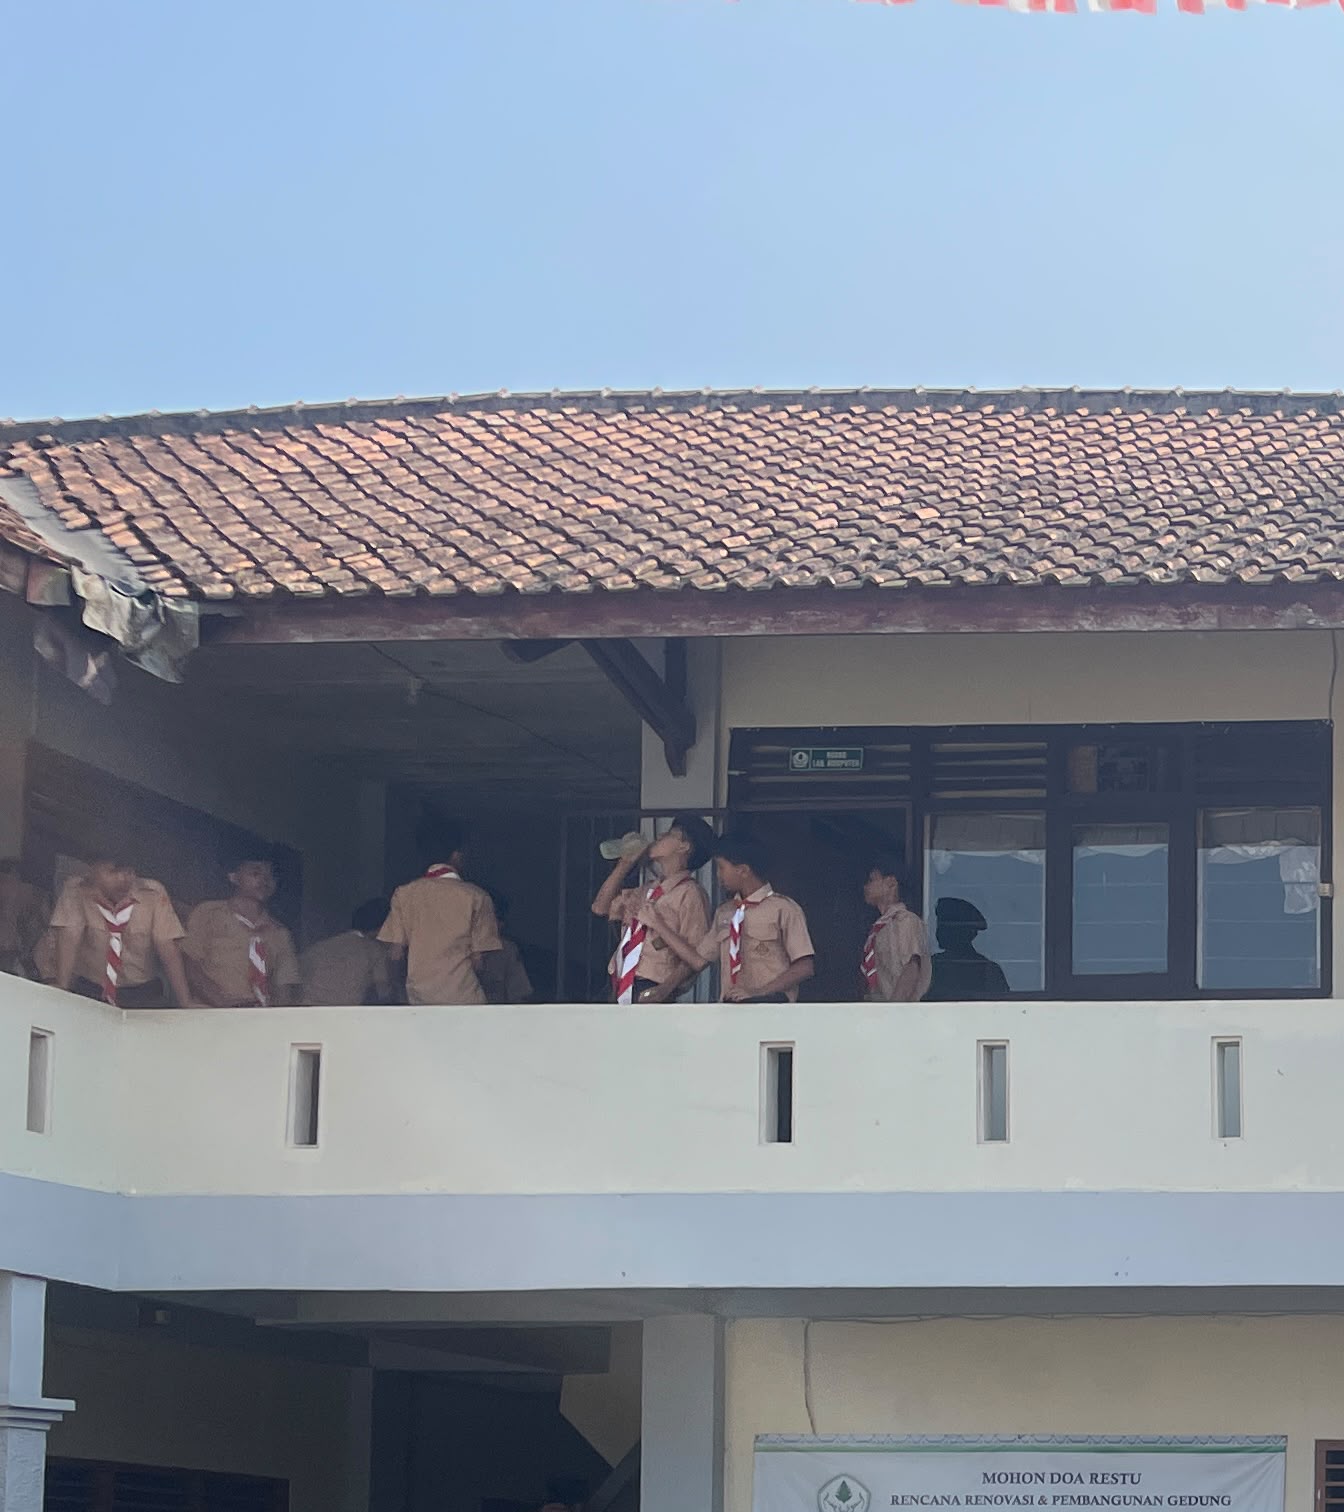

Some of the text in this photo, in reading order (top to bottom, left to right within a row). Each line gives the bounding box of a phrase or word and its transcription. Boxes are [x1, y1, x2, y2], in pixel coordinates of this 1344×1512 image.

[982, 1472, 1142, 1485] MOHON DOA RESTU
[890, 1494, 1232, 1507] RENCANA RENOVASI & PEMBANGUNAN GEDUNG
